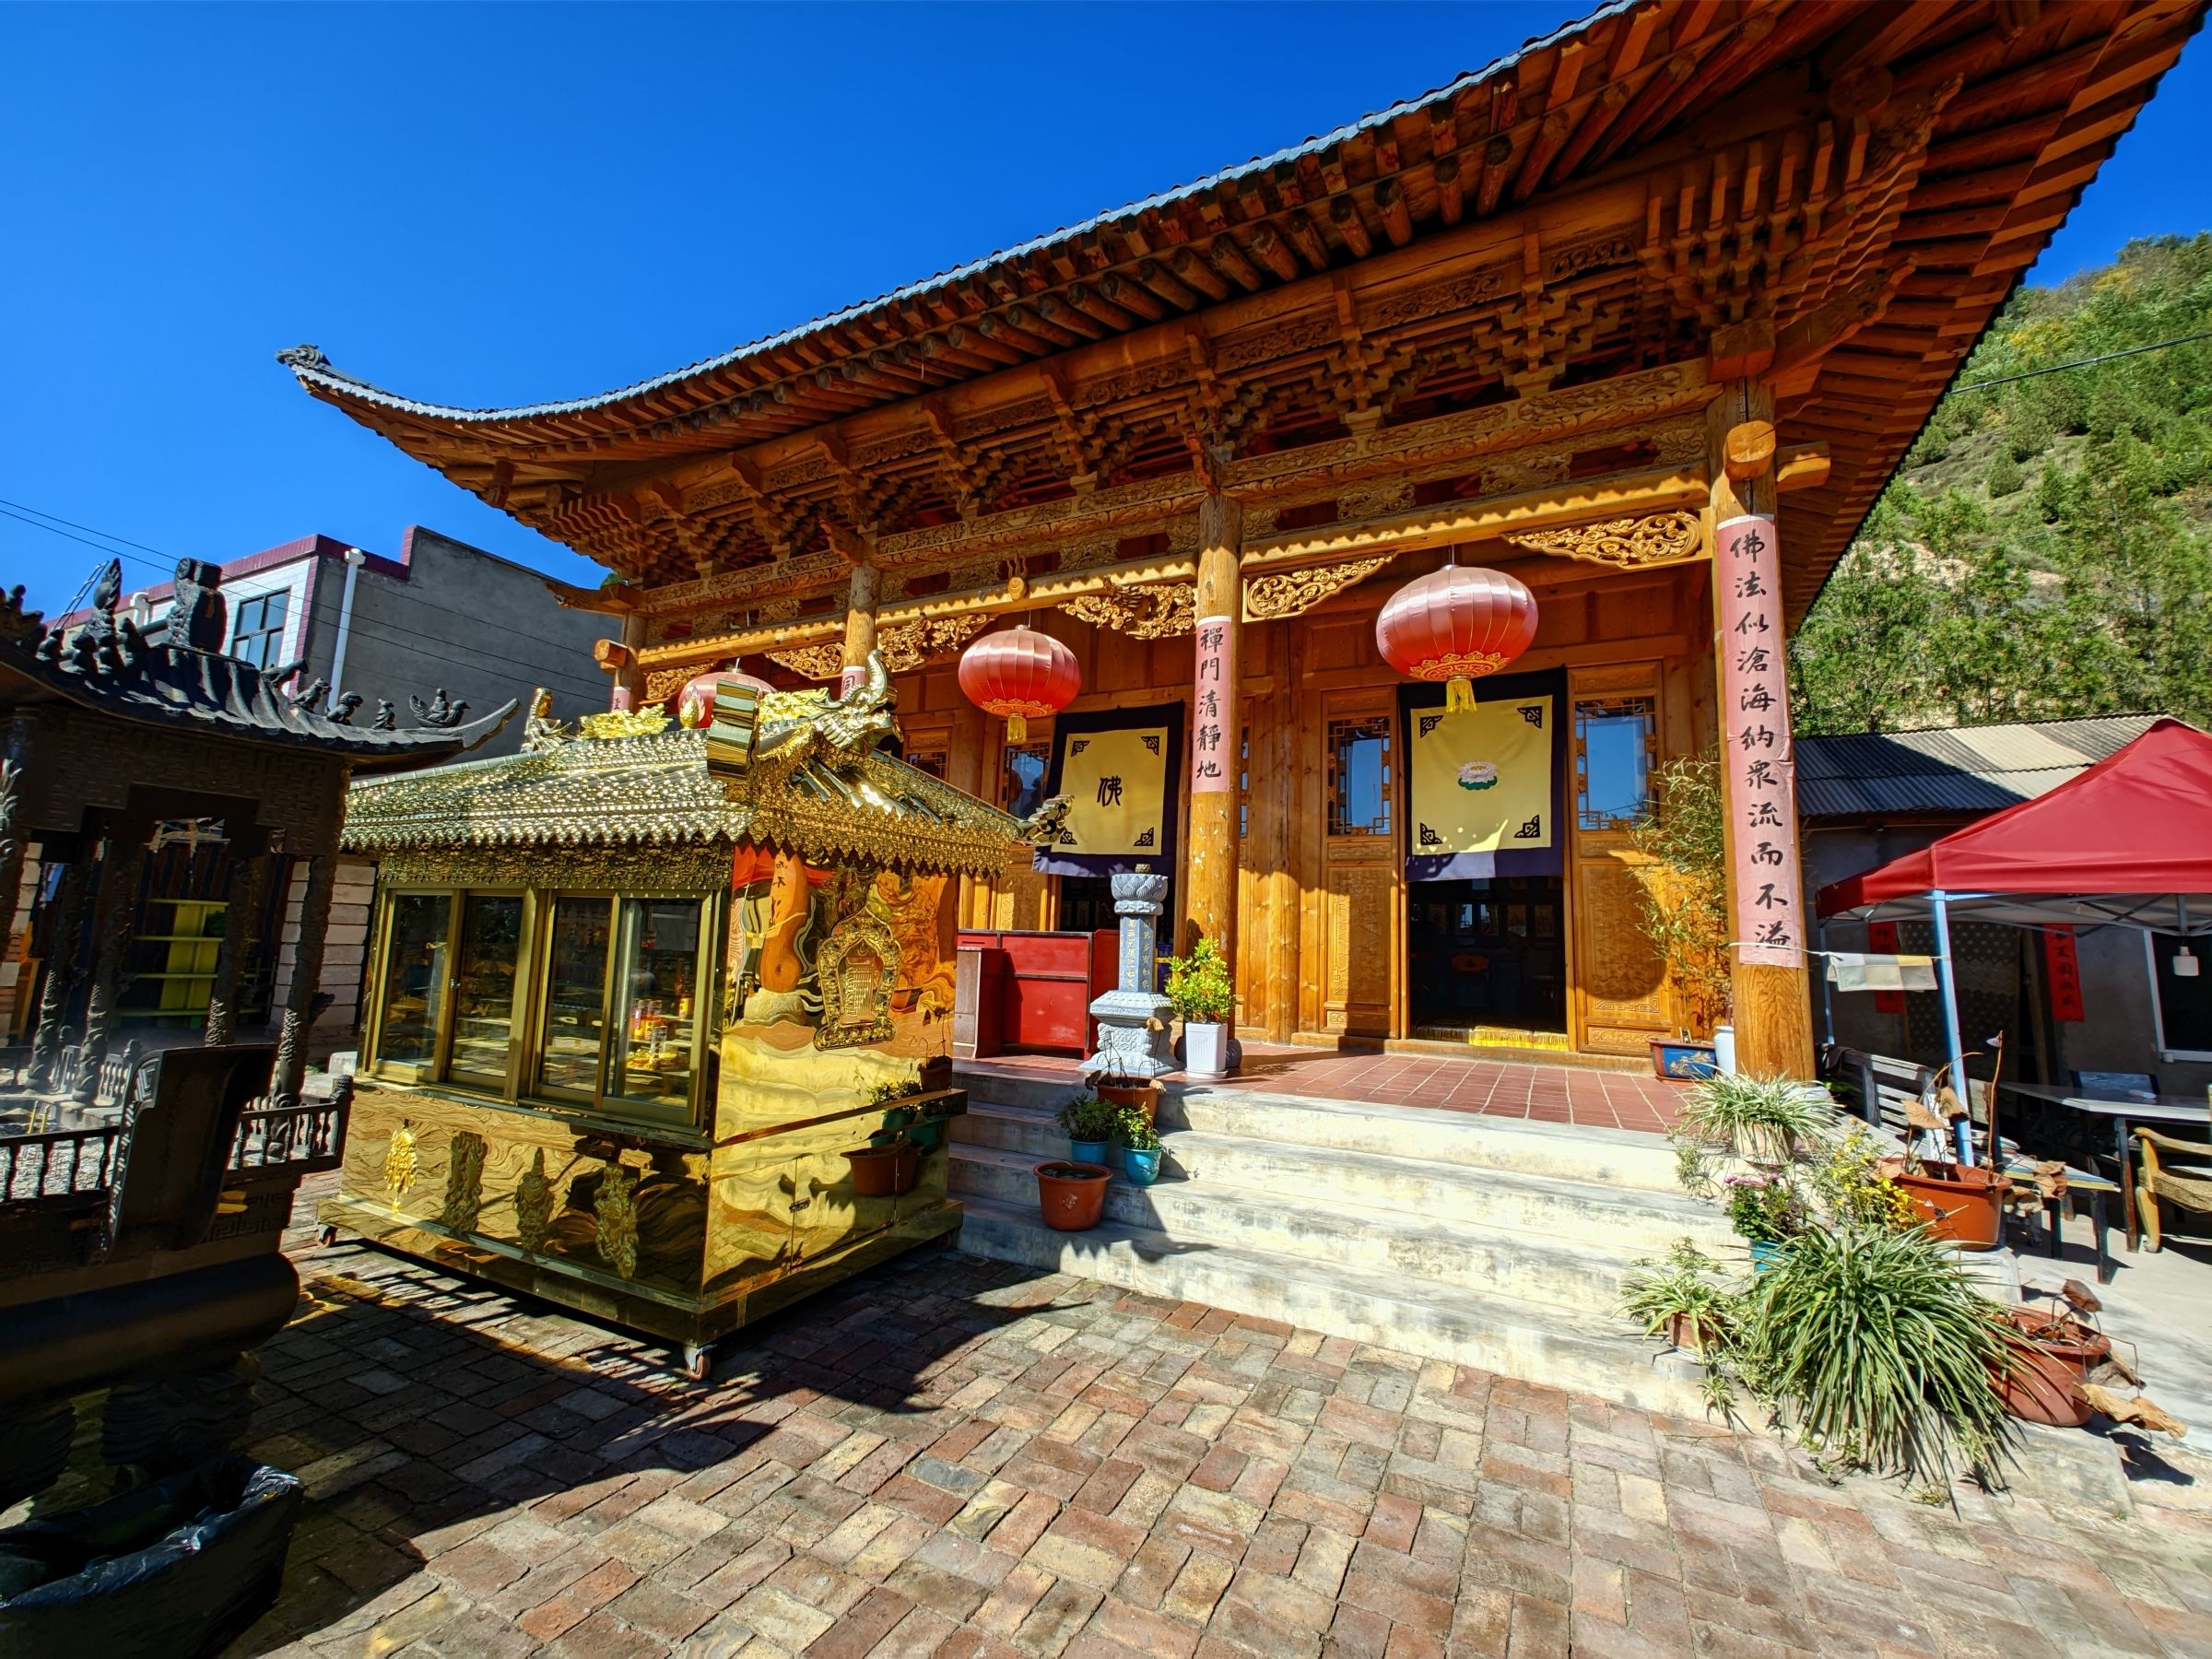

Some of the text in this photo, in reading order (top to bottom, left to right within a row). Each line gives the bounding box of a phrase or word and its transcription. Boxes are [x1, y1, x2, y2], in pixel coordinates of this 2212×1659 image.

[1196, 627, 1224, 779] 禪門清靜地
[1097, 775, 1123, 807] 佛
